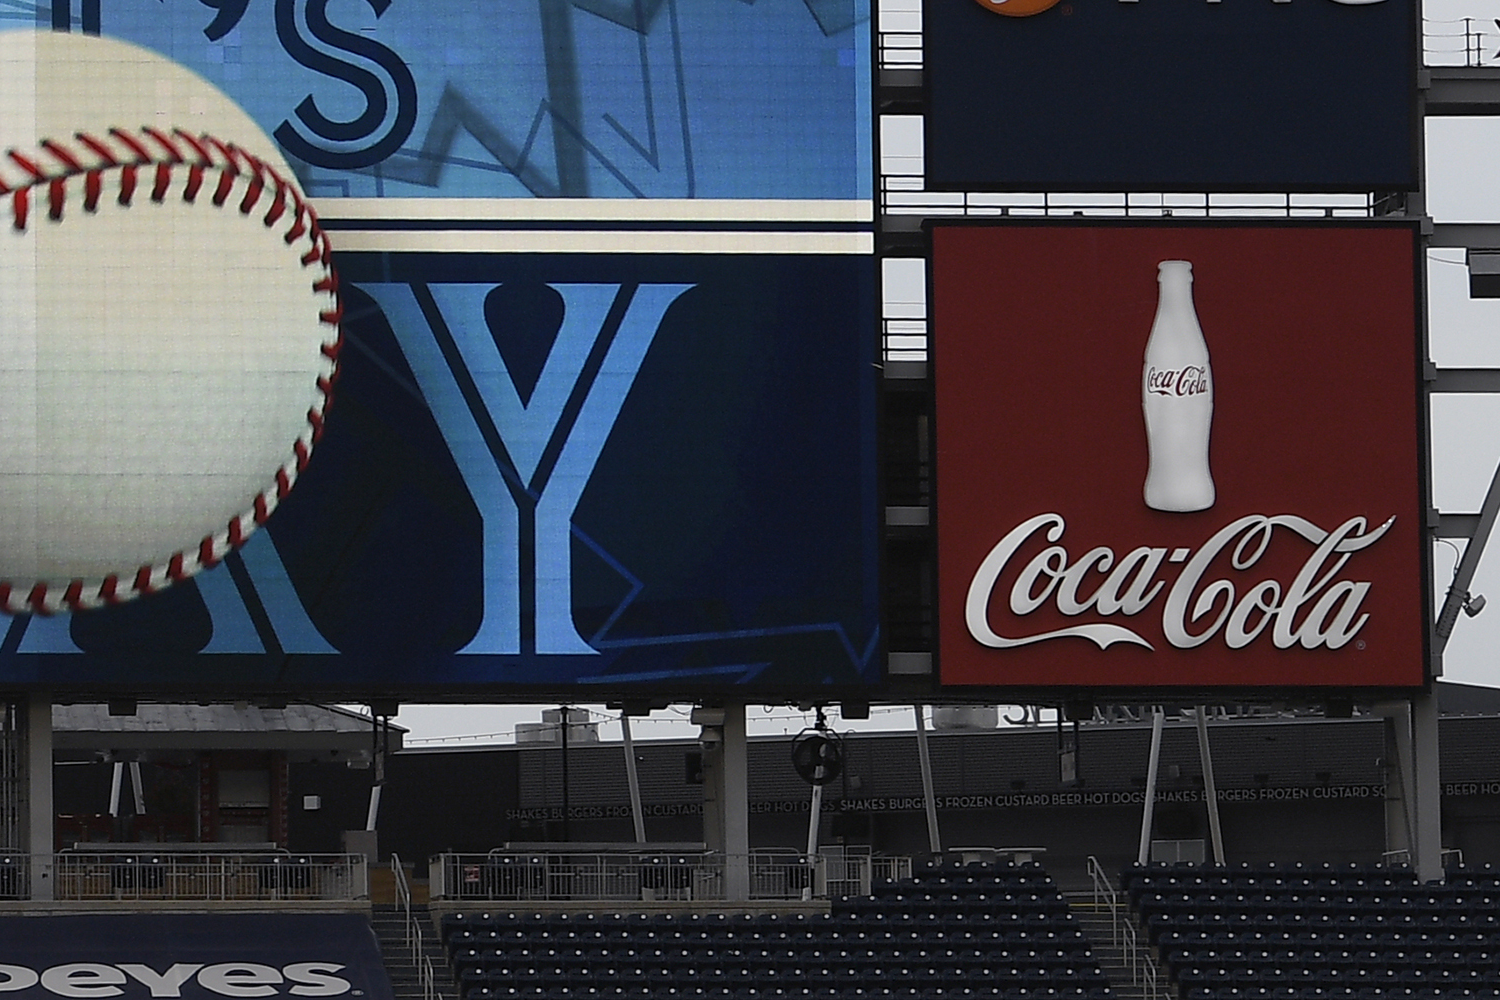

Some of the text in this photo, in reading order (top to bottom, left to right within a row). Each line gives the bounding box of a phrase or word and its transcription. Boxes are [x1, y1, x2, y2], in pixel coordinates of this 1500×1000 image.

[1147, 365, 1207, 397] Coca-Cola
[965, 512, 1397, 652] Coca-Cola
[750, 802, 771, 813] EER
[774, 801, 798, 812] HOT
[801, 800, 835, 812] DGS
[840, 799, 886, 811] SHAKES
[889, 797, 943, 810] BURGES
[945, 795, 993, 808] FROZEN
[995, 794, 1049, 807] CUSTARD
[1051, 793, 1082, 805] BEER
[1084, 792, 1109, 804] HOT
[1201, 789, 1257, 801] BRGERS
[1260, 787, 1309, 800] FROZEN
[1313, 786, 1370, 799] CUSTARD
[1446, 783, 1477, 796] BEER
